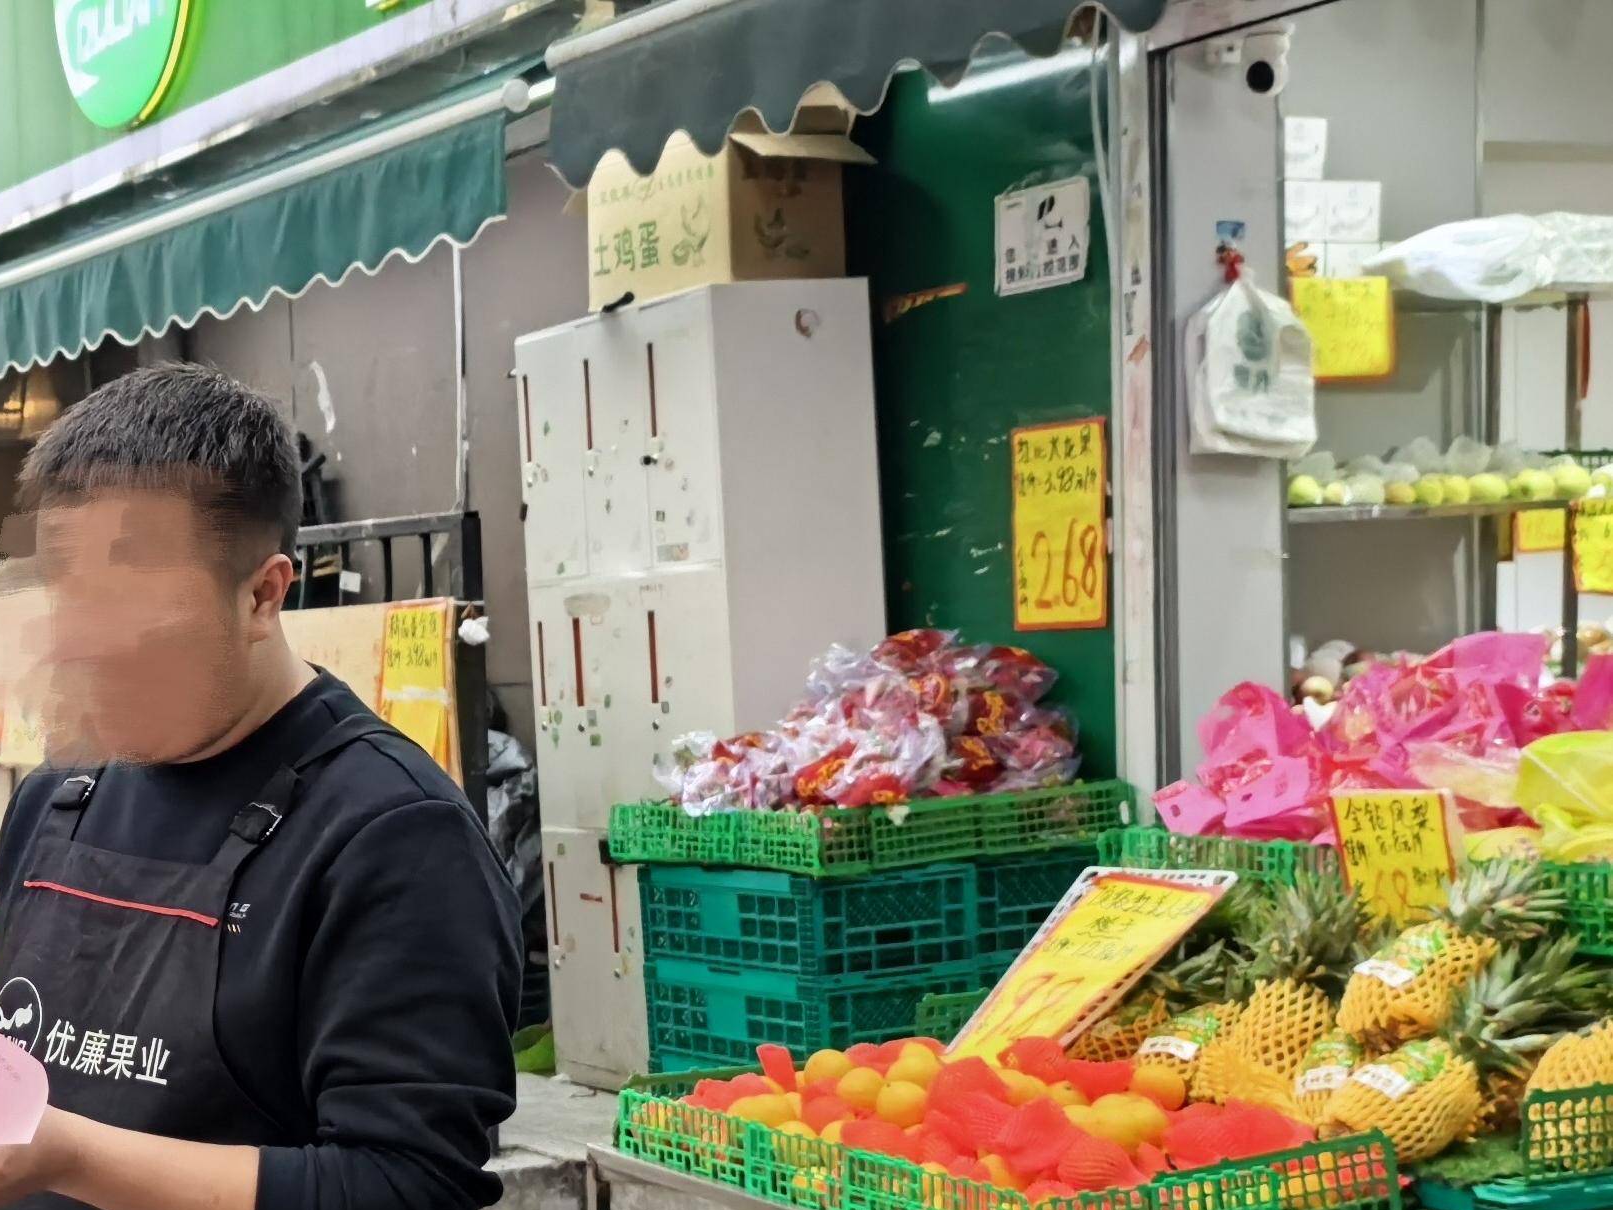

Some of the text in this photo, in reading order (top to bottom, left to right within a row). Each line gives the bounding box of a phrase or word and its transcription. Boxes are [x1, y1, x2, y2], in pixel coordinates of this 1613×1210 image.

[593, 220, 660, 277] 土鸡蛋
[1030, 517, 1098, 610] 2.68
[44, 1018, 170, 1086] 优廉果业
